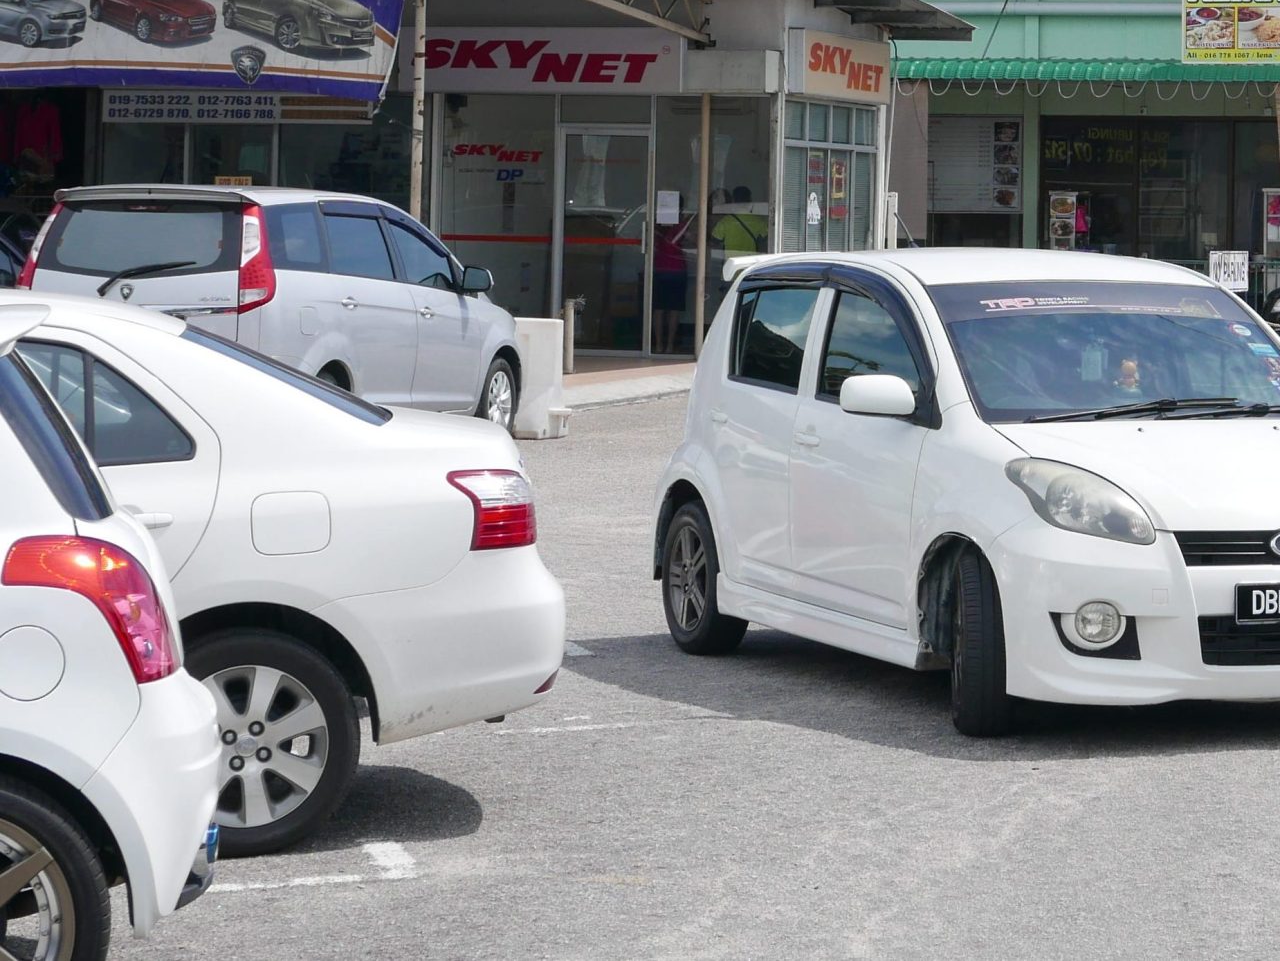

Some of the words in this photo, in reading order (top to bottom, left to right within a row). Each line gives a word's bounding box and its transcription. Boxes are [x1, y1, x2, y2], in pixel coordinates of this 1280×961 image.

[411, 38, 658, 84] SKYNET
[808, 42, 884, 93] SKYNET
[108, 95, 165, 105] 019-7533
[198, 96, 252, 107] 012-7763
[108, 108, 164, 118] 012-6729
[197, 109, 251, 119] 012-7166
[453, 143, 545, 163] SKYNET
